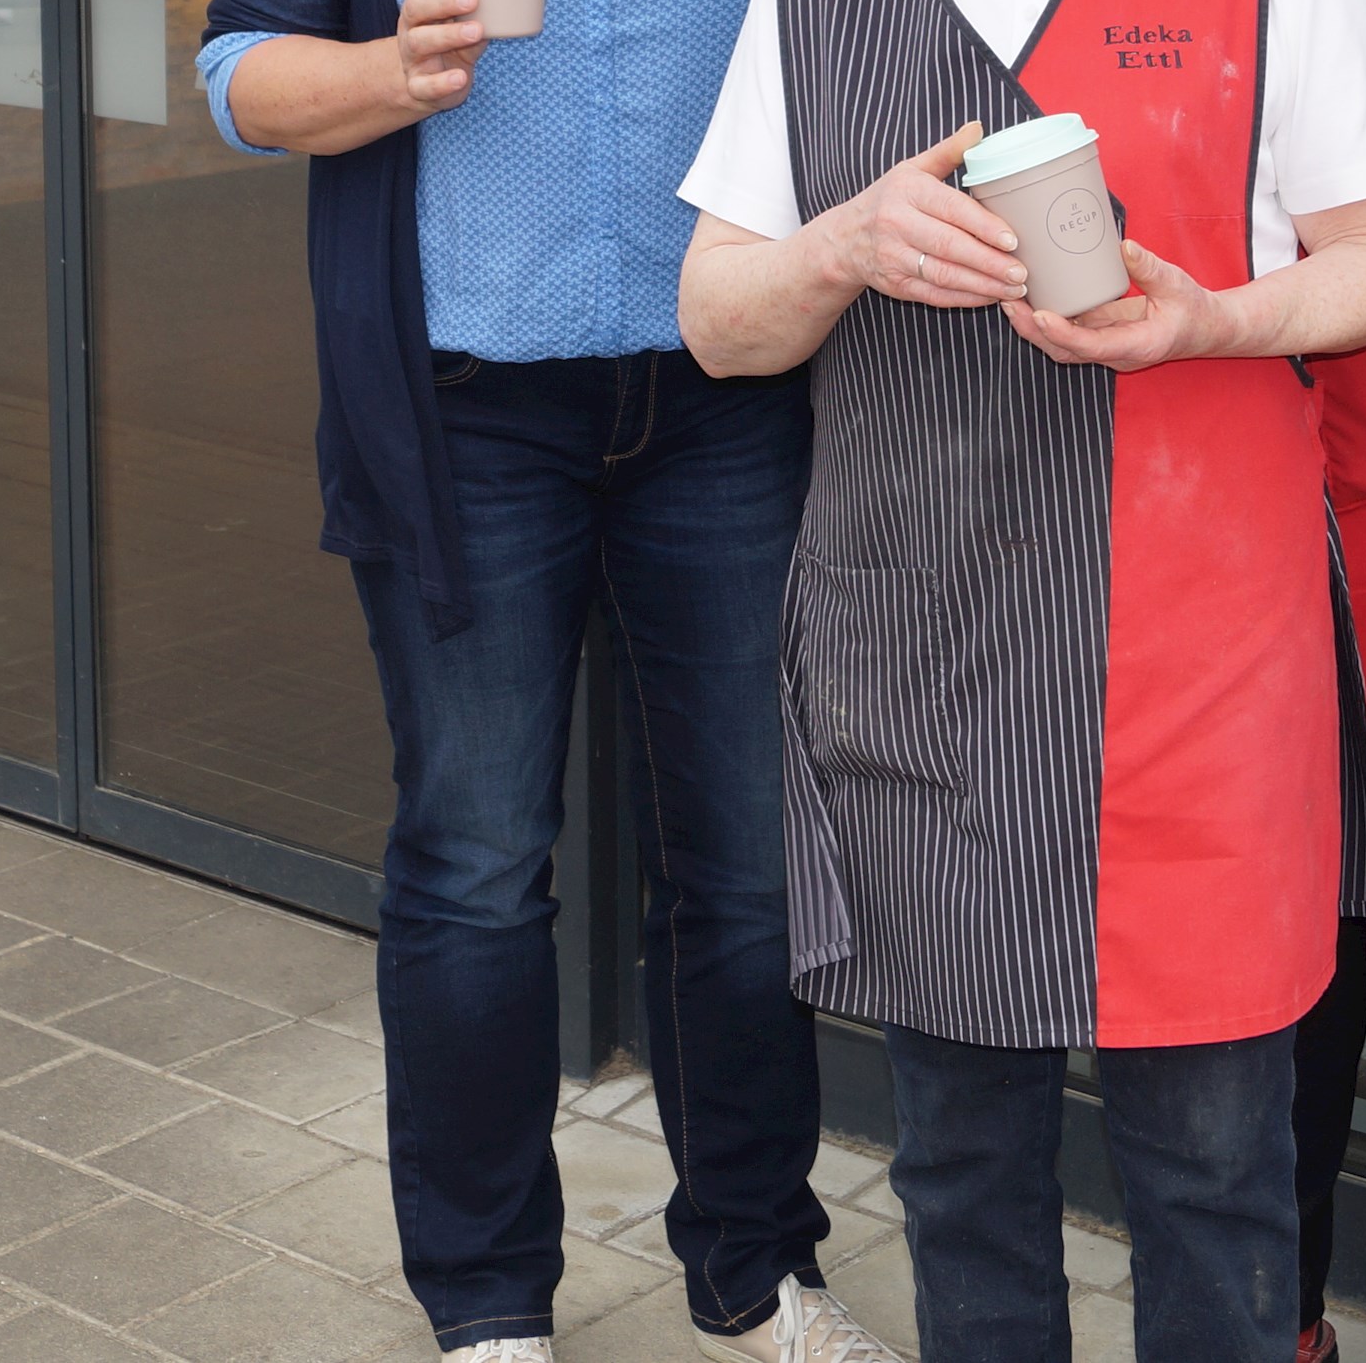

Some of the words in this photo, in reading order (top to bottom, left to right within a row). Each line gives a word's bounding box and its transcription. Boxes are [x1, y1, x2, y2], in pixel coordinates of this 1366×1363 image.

[1103, 24, 1193, 45] Edeka
[1116, 50, 1183, 69] Ettl
[1059, 211, 1098, 233] RECUP
